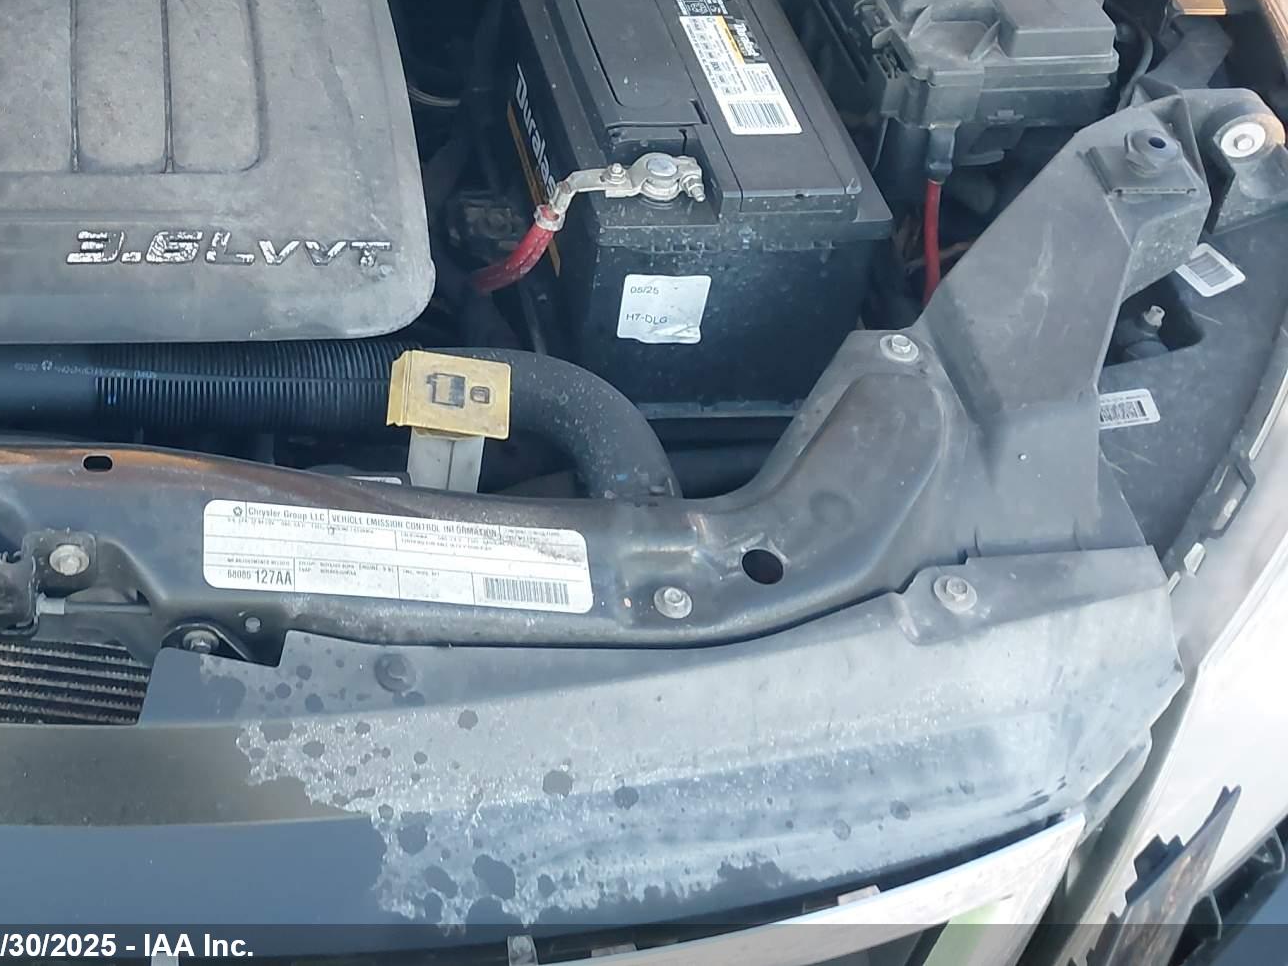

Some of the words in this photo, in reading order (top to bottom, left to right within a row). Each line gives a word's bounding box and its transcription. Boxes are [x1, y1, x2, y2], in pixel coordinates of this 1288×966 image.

[515, 63, 558, 199] Duralas
[248, 507, 281, 519] Chrysler
[283, 510, 308, 522] Group
[310, 512, 325, 522] LLC
[331, 513, 363, 525] VEHICLE
[365, 516, 403, 529] EMISSION
[405, 520, 441, 532] CONTROL
[443, 524, 497, 538] INFORMATION
[255, 569, 293, 586] 127AA
